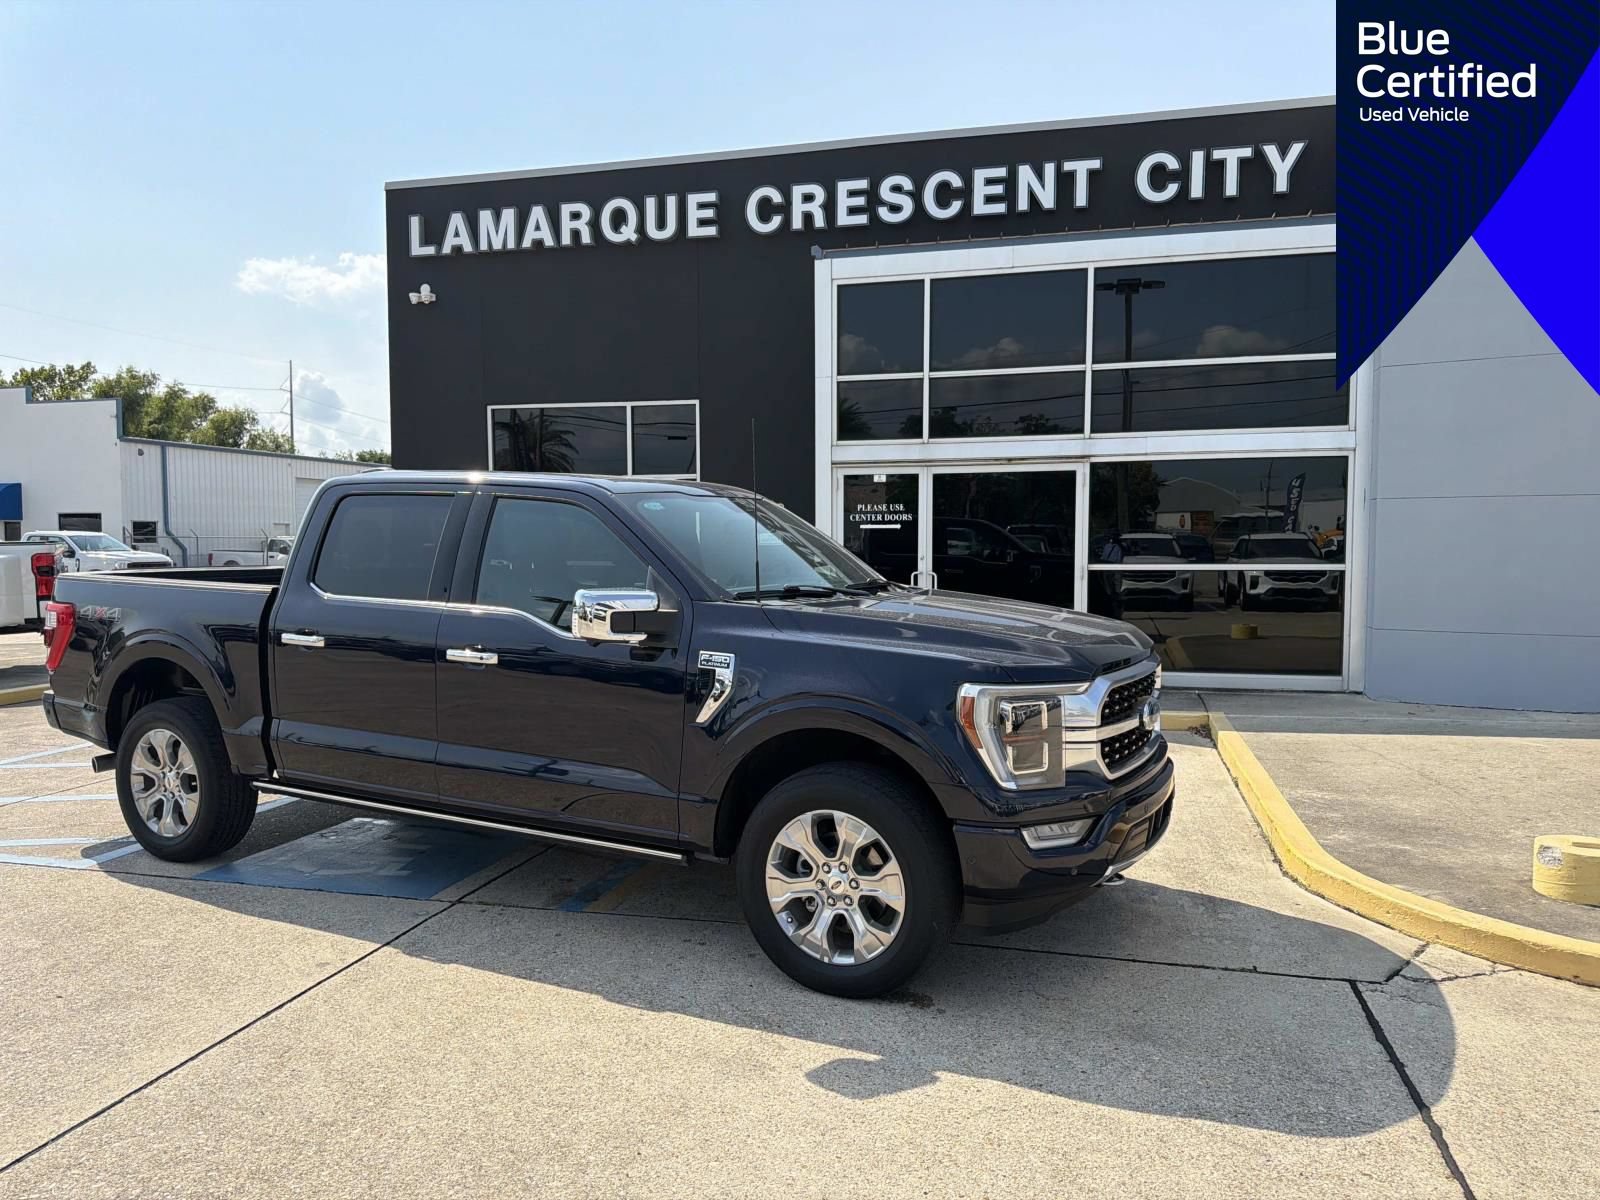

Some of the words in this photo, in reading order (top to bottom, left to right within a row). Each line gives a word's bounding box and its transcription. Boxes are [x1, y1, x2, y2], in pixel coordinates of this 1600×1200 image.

[408, 190, 720, 257] LAMARQUE
[745, 157, 1102, 236] CRESCENT
[1134, 139, 1309, 204] CITY
[857, 503, 888, 512] PLEASE
[889, 503, 905, 512] USE
[849, 513, 883, 522] CENTER
[884, 513, 913, 521] DOORS
